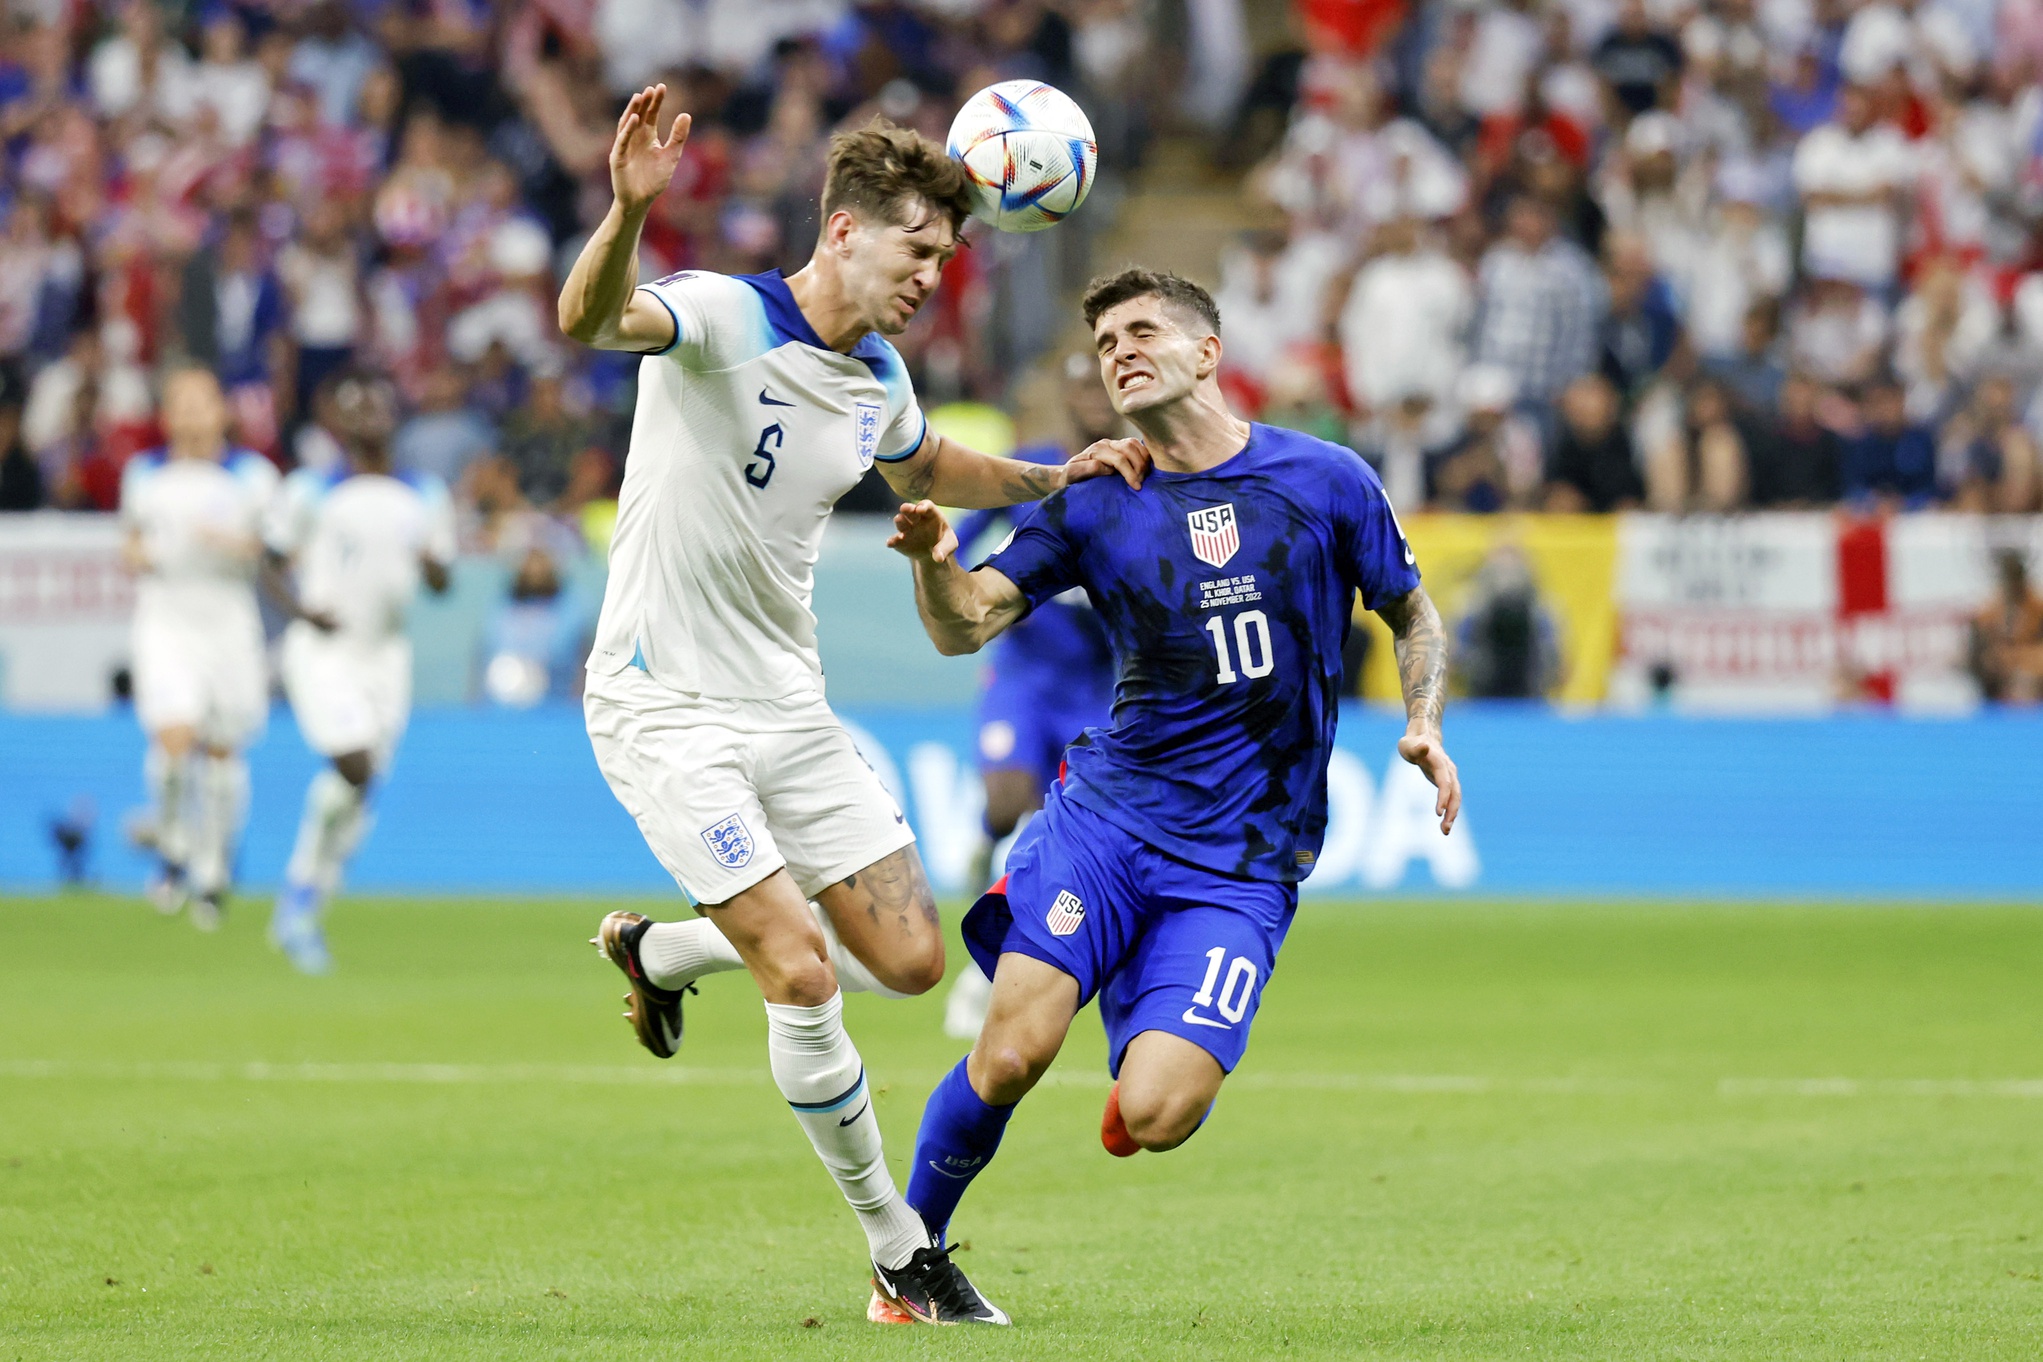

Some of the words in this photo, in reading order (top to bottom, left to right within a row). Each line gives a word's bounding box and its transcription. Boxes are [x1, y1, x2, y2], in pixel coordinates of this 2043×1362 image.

[744, 423, 784, 490] 5
[1191, 507, 1232, 534] USA
[1200, 578, 1231, 591] ENGLAND
[1230, 577, 1242, 586] VS.
[1241, 574, 1256, 584] USA
[1204, 590, 1214, 599] AL
[1233, 583, 1256, 595] QATAR
[1199, 599, 1210, 609] 25
[1210, 594, 1245, 607] NOVEMBER
[1244, 591, 1263, 602] 2022
[1205, 609, 1275, 685] 10
[1058, 893, 1085, 916] USA
[1191, 946, 1258, 1024] 10
[944, 1155, 982, 1168] USA
